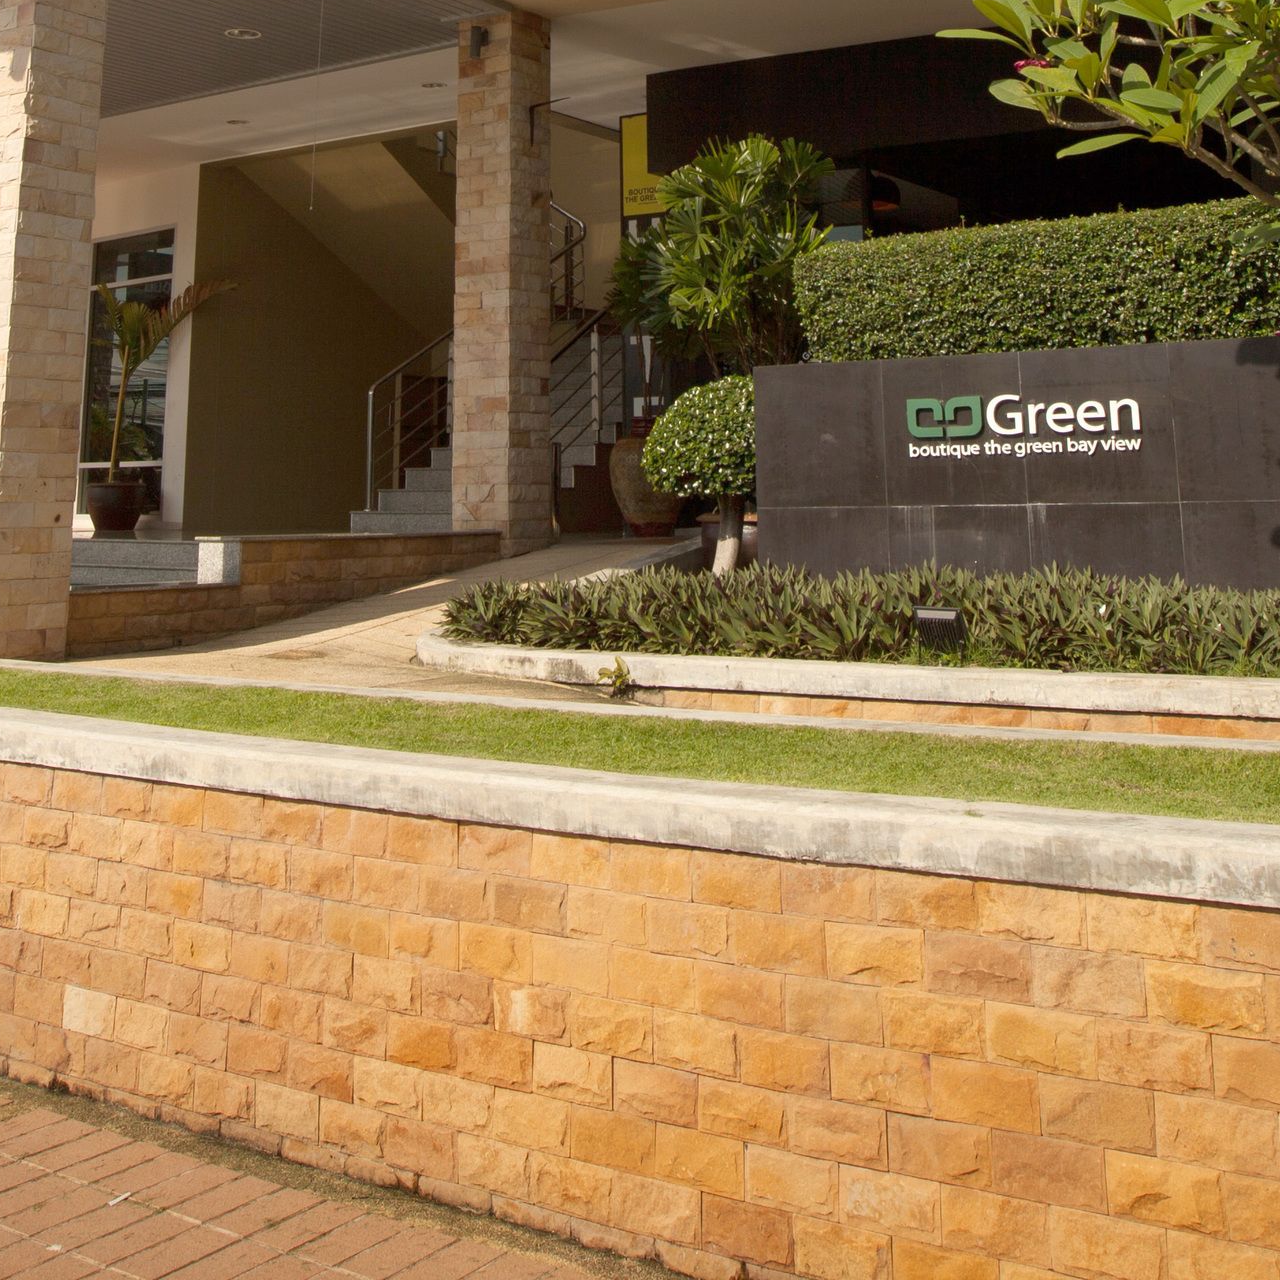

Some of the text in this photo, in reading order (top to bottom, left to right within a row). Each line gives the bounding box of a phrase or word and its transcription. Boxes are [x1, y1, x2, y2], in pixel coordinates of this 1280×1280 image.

[625, 195, 638, 204] THE
[986, 394, 1141, 436] Green
[908, 435, 1141, 459] boutique the green bay view
